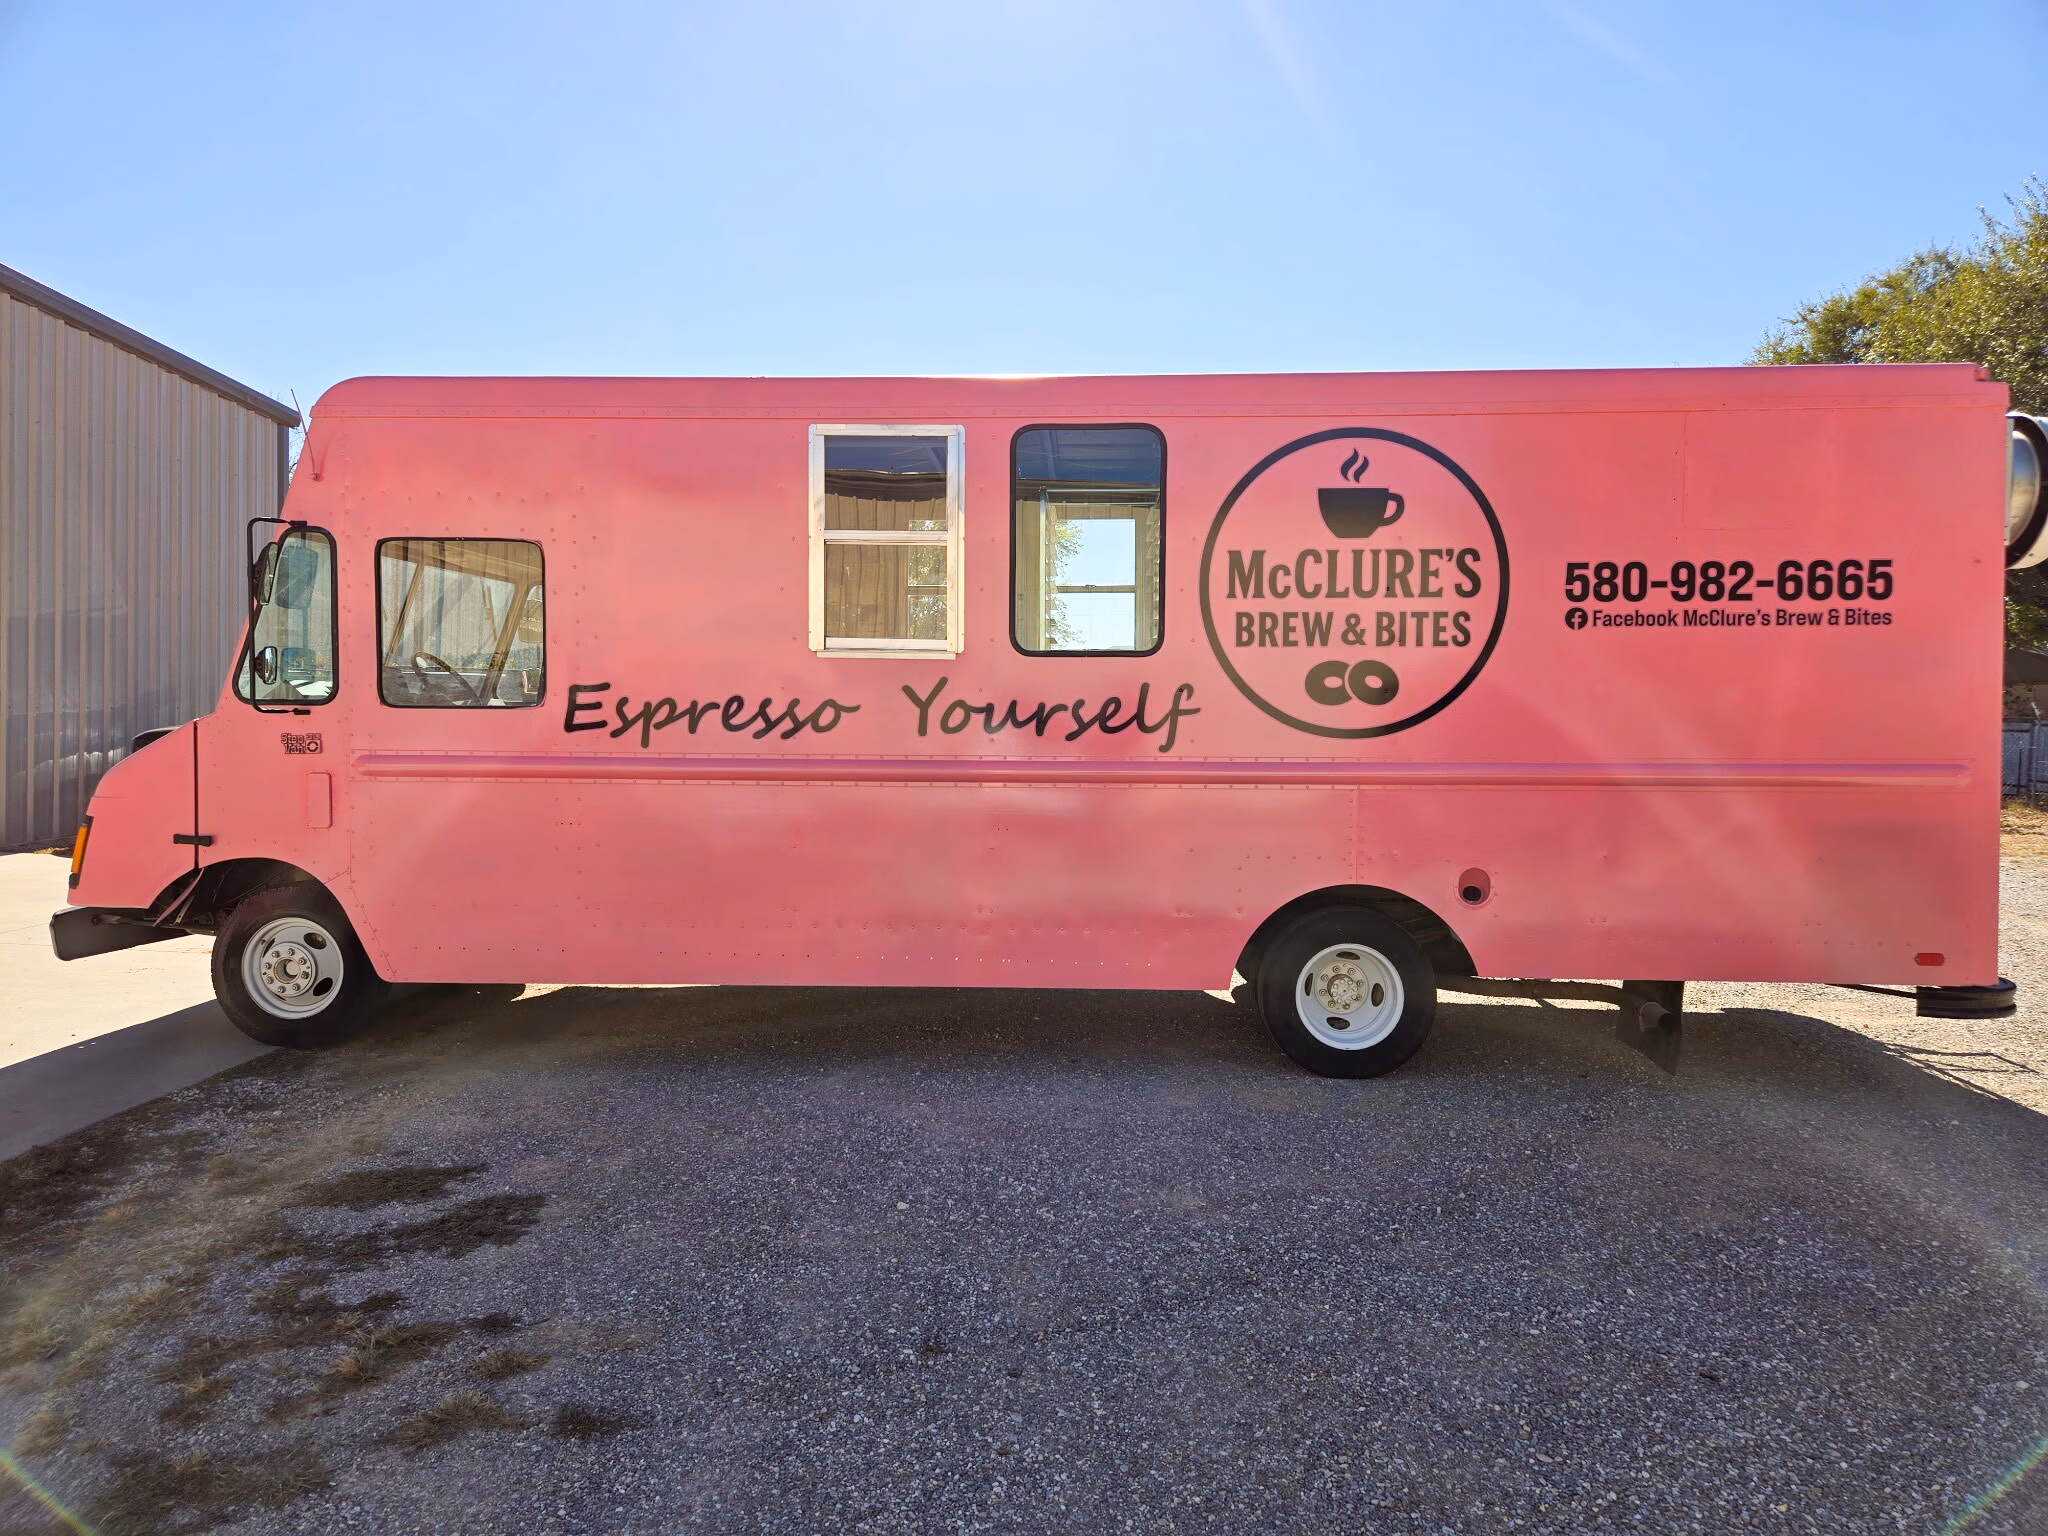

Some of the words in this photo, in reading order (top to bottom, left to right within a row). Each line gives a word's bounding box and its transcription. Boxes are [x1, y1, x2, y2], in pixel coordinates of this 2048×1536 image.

[1227, 548, 1482, 599] McCLURE'S
[1564, 559, 1893, 603] 580-982-6665
[1235, 611, 1334, 648] BREW
[1341, 613, 1366, 646] &
[1376, 611, 1471, 648] BITES
[1593, 610, 1678, 627] Facebook
[1684, 609, 1770, 627] McClure's
[1776, 609, 1822, 626] Brew
[1827, 609, 1839, 626] &
[1845, 609, 1892, 626] Bites
[564, 682, 861, 748] Espresso
[901, 676, 1201, 753] Yourself
[281, 733, 304, 744] Step
[284, 744, 304, 753] Van
